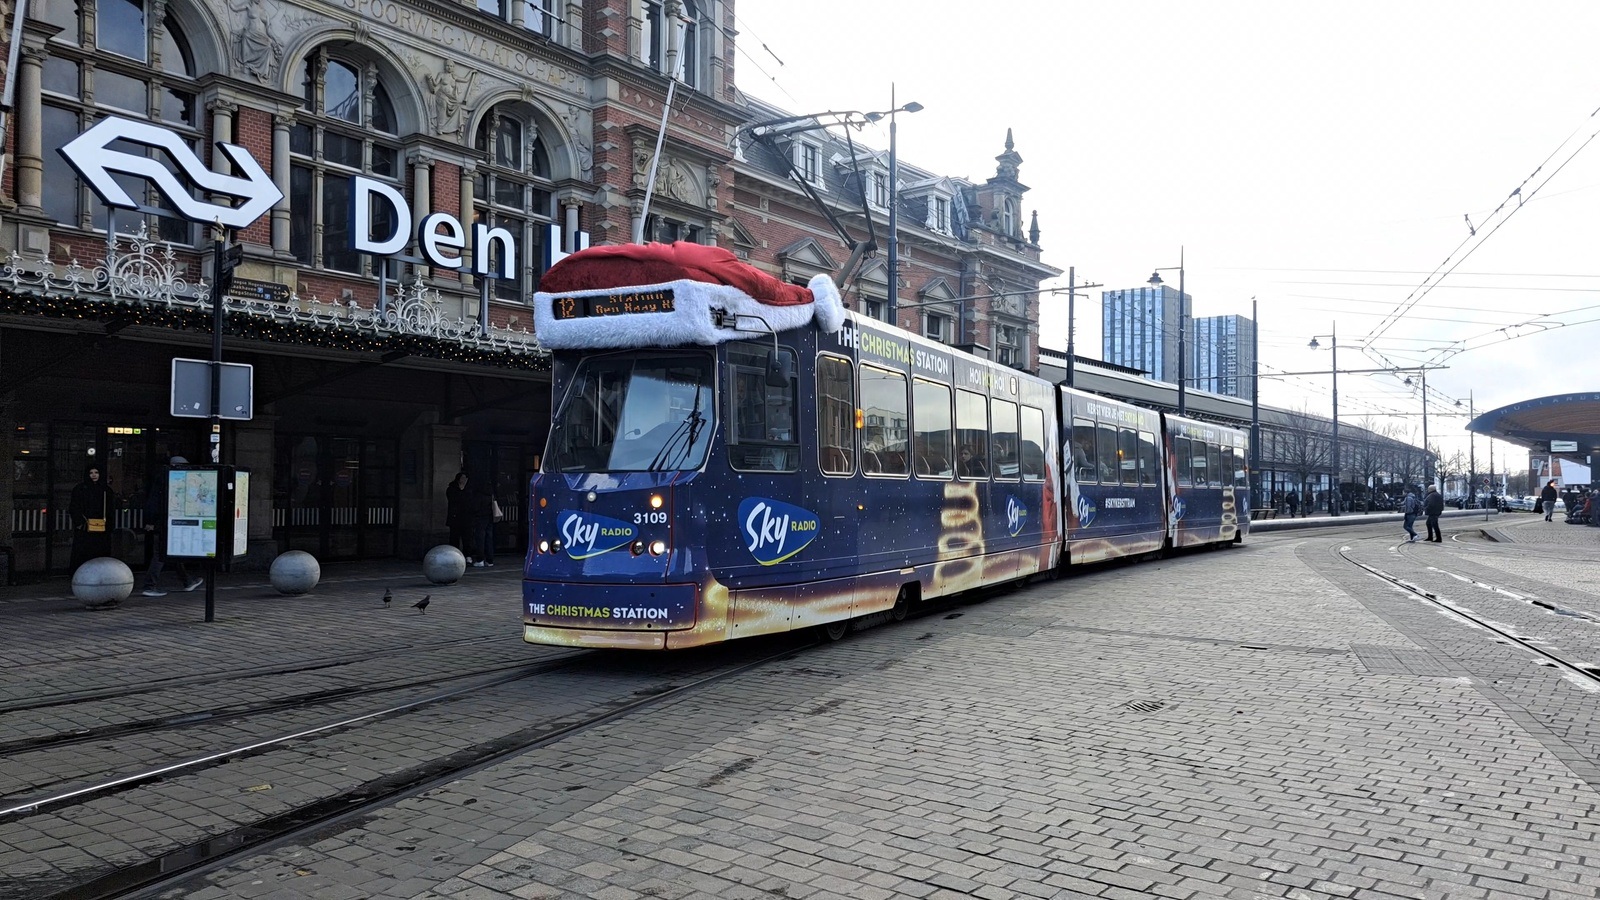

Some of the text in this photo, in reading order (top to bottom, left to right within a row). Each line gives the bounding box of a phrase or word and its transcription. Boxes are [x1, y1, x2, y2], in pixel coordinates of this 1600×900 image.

[349, 175, 516, 281] Den
[558, 297, 576, 319] 12
[837, 327, 949, 376] THE CHRISTMAS STATION
[562, 513, 632, 553] Sky RADIO
[633, 512, 668, 524] 3109
[745, 501, 817, 554] Sky RADIO
[529, 603, 668, 619] THE CHRISTMAS STATION
